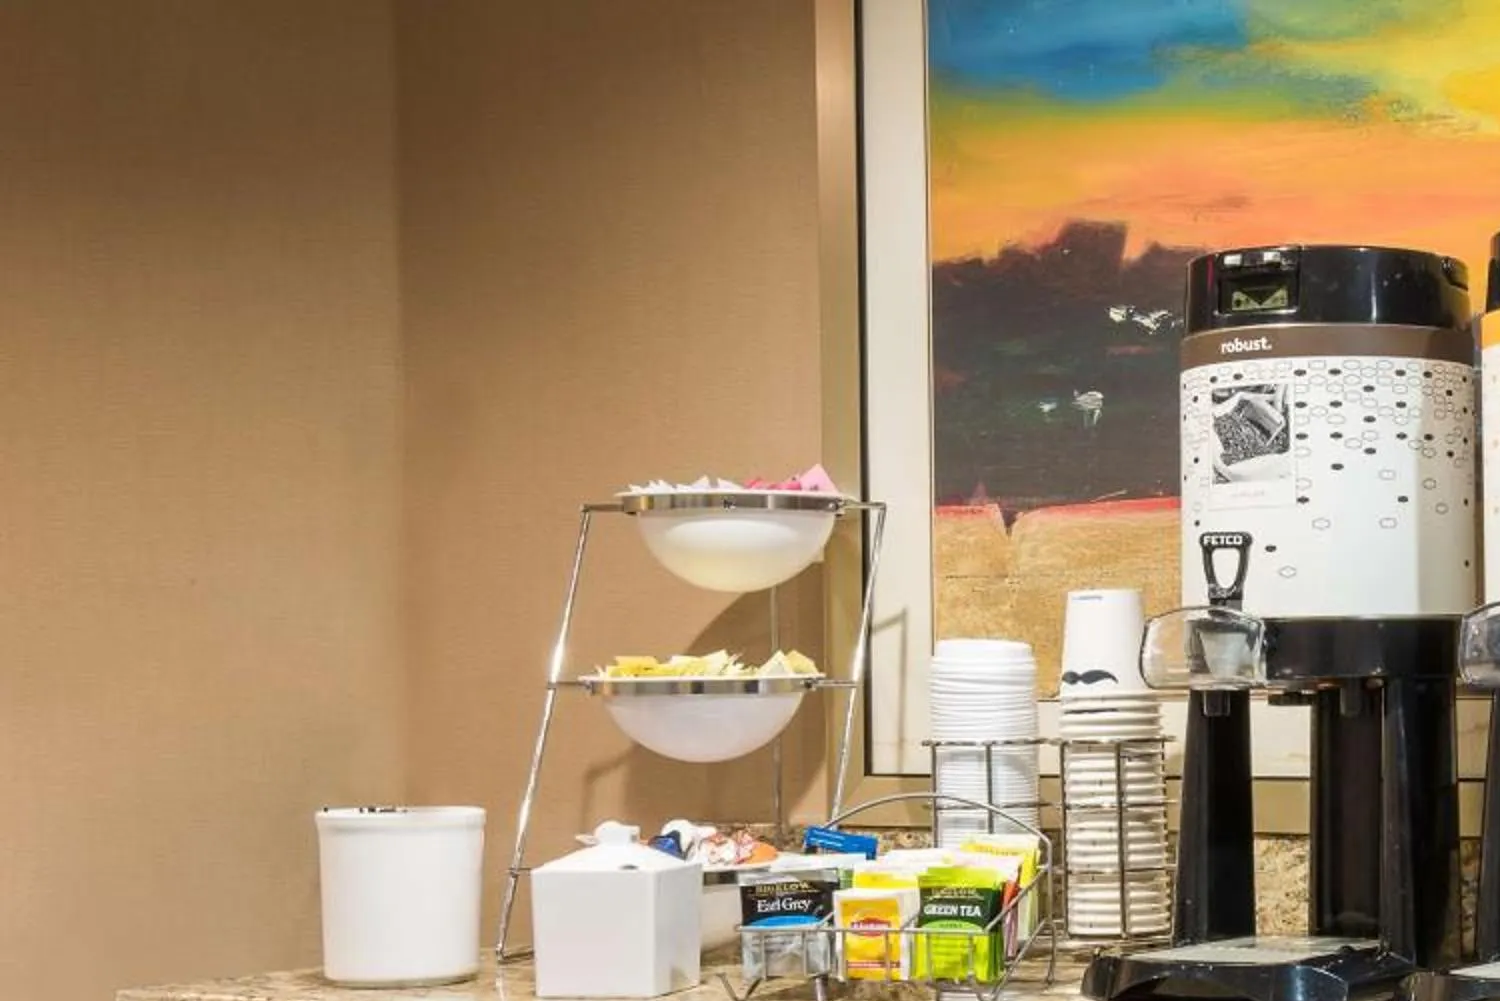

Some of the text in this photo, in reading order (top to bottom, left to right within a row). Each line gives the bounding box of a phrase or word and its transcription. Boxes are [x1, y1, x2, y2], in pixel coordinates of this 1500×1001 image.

[1221, 336, 1273, 355] robust.
[1203, 535, 1243, 546] FETCO
[757, 897, 812, 912] Earl Grey
[923, 903, 982, 916] GREEN TEA
